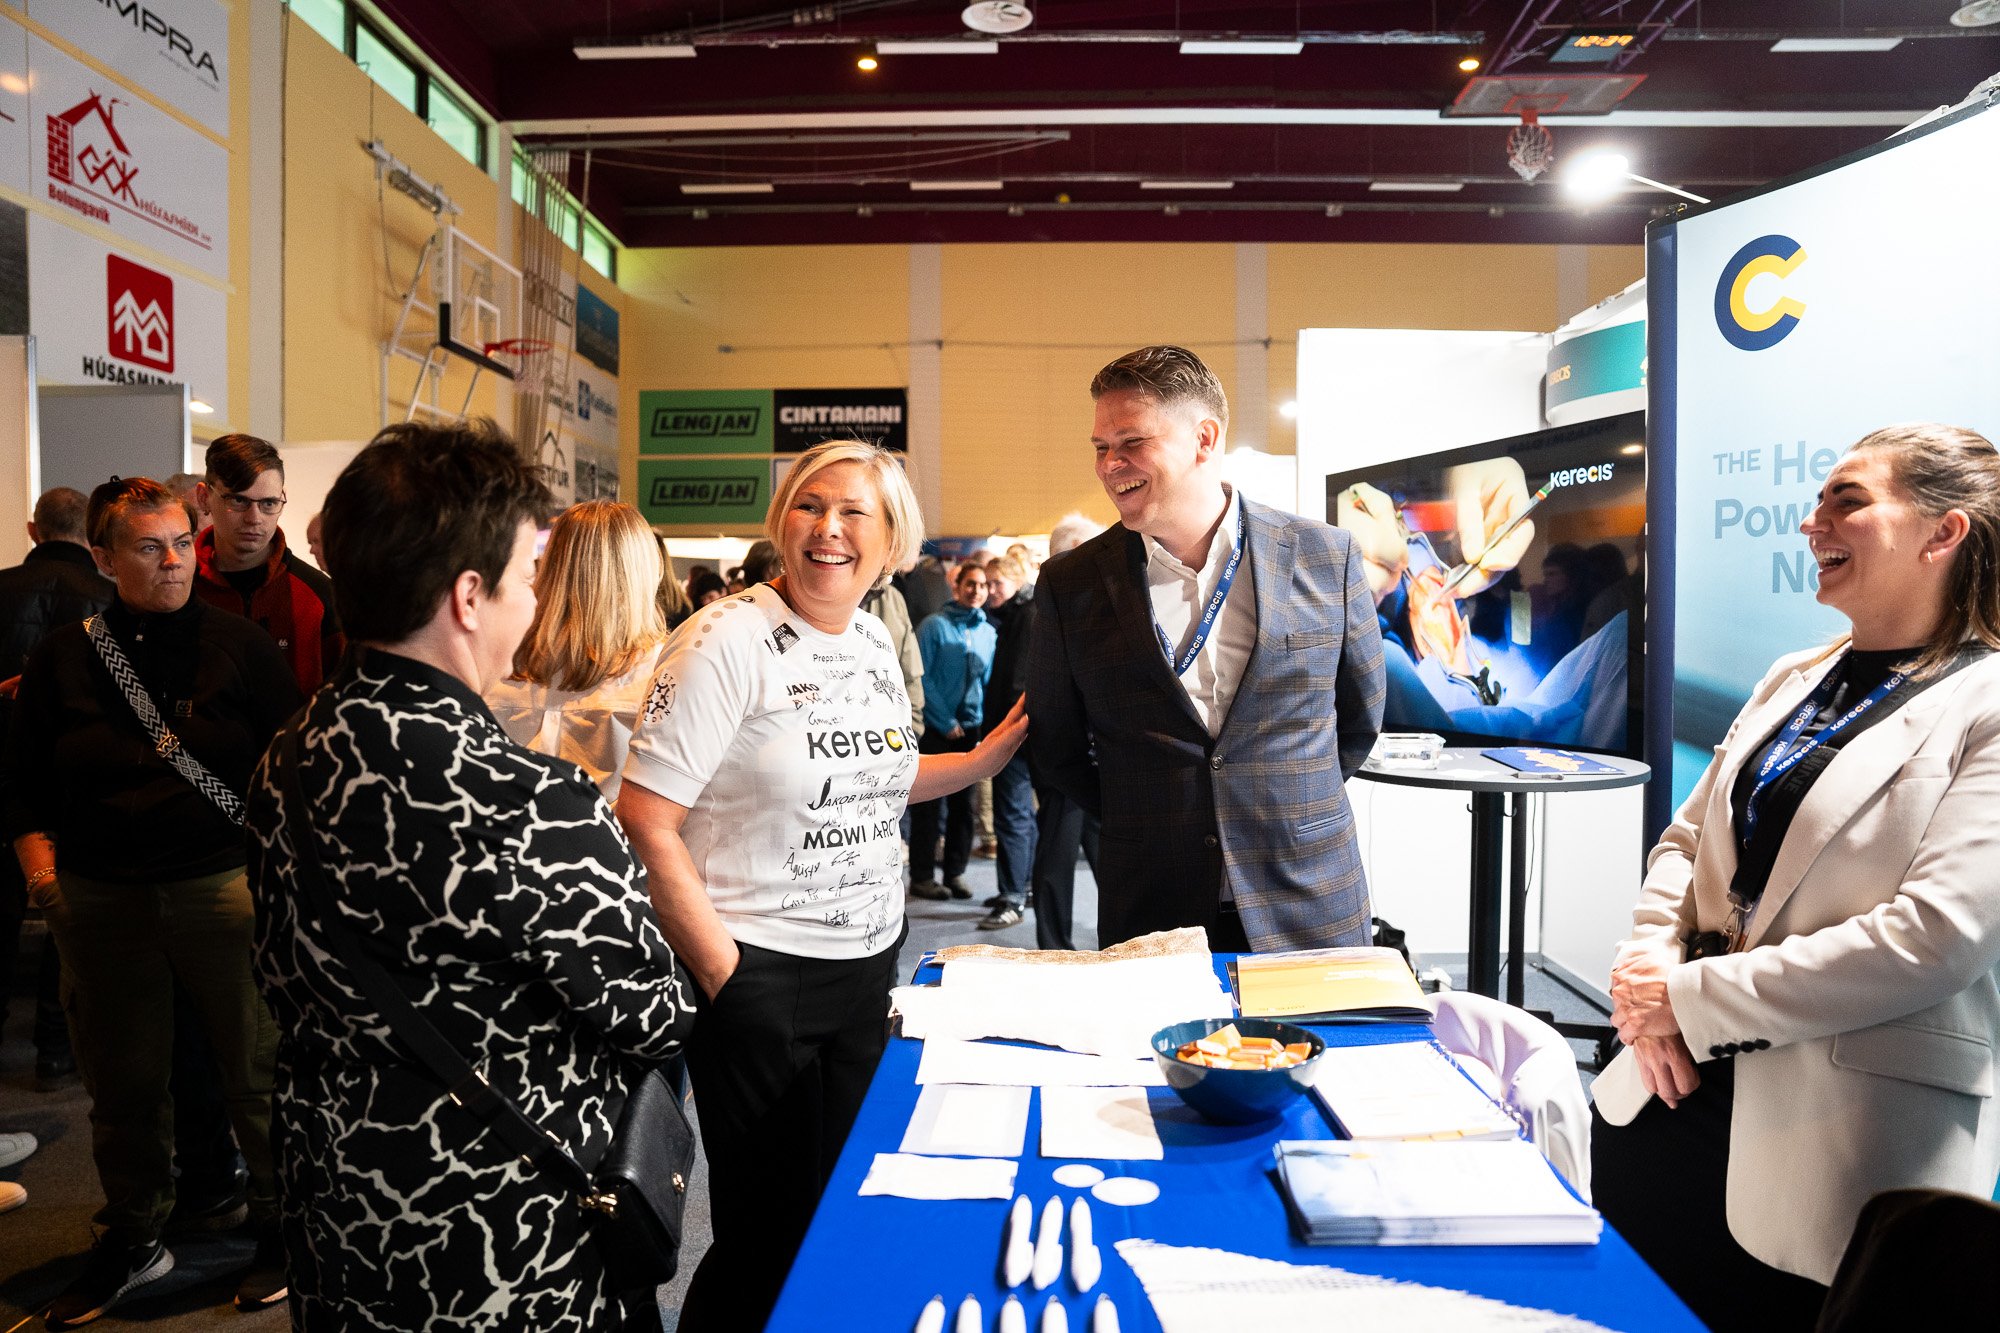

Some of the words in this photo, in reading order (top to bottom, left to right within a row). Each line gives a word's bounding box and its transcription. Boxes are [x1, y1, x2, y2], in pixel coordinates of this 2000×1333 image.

[97, 0, 219, 82] MPRA
[780, 405, 901, 425] CINTAMANI
[1713, 448, 1761, 475] THE
[1773, 440, 1839, 486] He
[1714, 498, 1812, 539] Pow
[786, 683, 820, 697] JAKO
